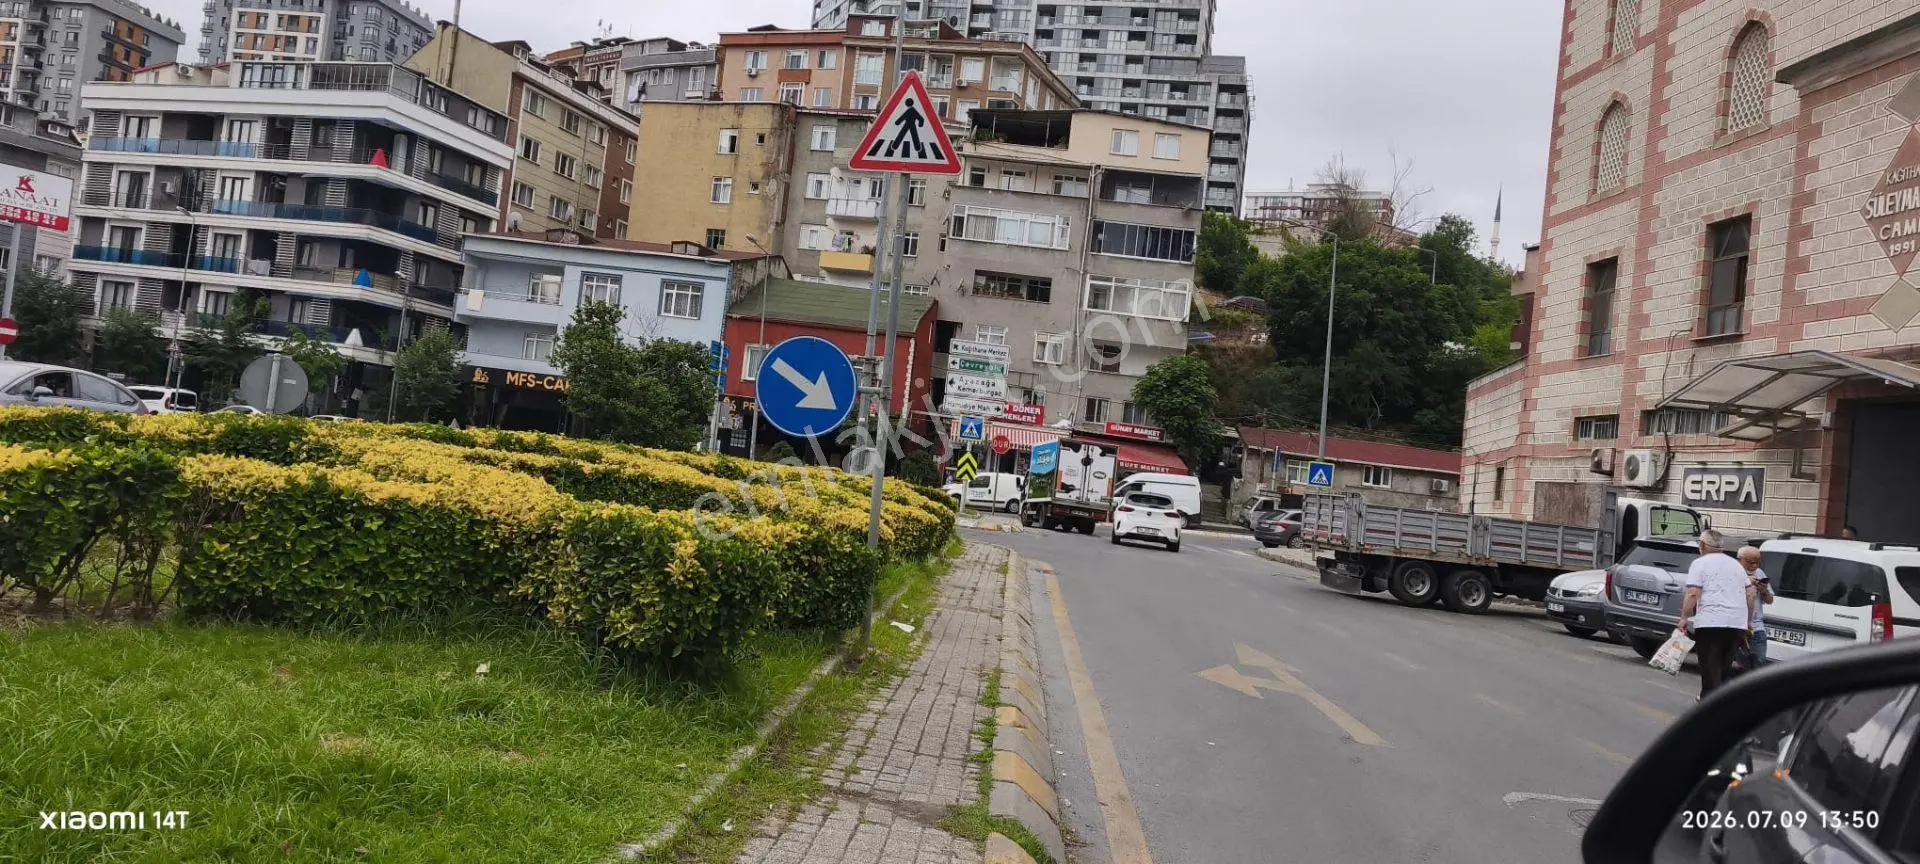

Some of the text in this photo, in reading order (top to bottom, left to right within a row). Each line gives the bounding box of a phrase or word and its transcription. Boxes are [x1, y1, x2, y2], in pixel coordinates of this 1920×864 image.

[1889, 240, 1915, 257] 1991
[988, 347, 1008, 357] Merkez
[959, 375, 996, 387] Ayazağa
[957, 385, 1002, 397] Kemerburgaz
[1012, 404, 1041, 415] DÖNER
[1133, 427, 1161, 437] MARKET
[993, 439, 1009, 448] DUR
[1140, 464, 1170, 473] MARKET
[1684, 474, 1758, 503] ERPA
[1789, 631, 1803, 642] 952
